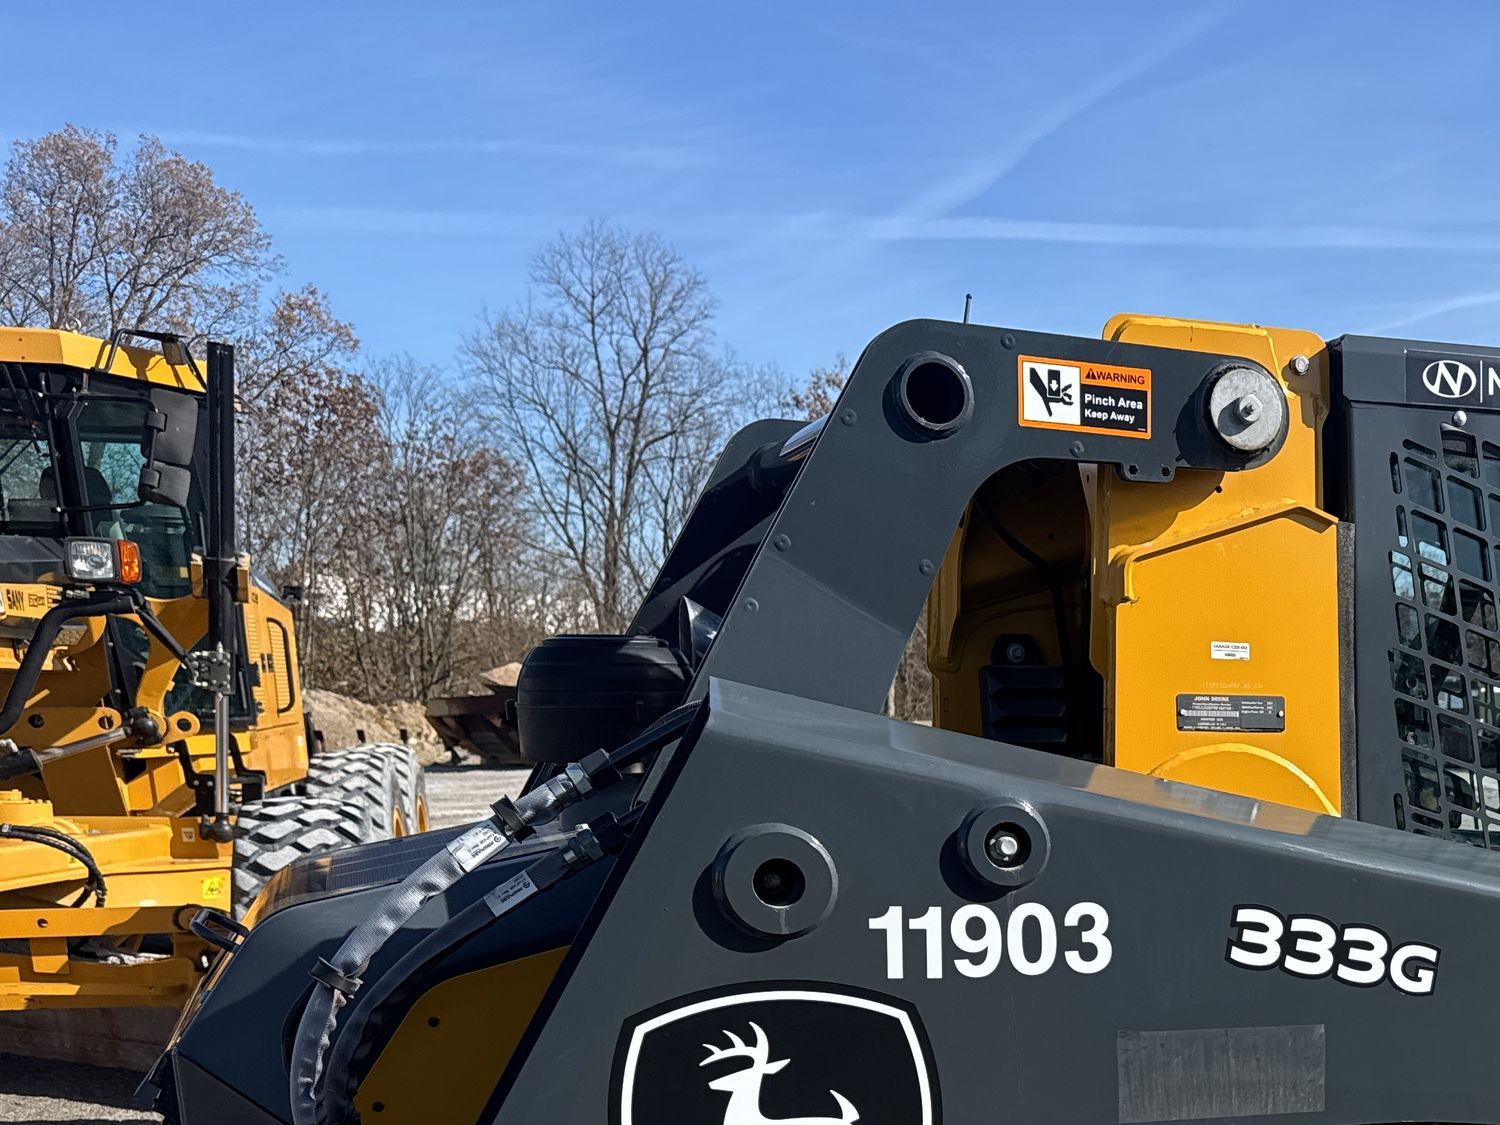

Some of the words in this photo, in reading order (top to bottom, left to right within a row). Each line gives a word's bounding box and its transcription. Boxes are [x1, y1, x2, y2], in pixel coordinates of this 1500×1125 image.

[1096, 371, 1145, 385] WARNING
[1084, 393, 1116, 407] Pinch
[1118, 398, 1143, 410] Area
[1084, 408, 1108, 421] Keep
[1110, 411, 1136, 424] Away
[6, 588, 25, 612] SANY
[868, 902, 1113, 979] 11903
[1228, 907, 1439, 994] 333G
